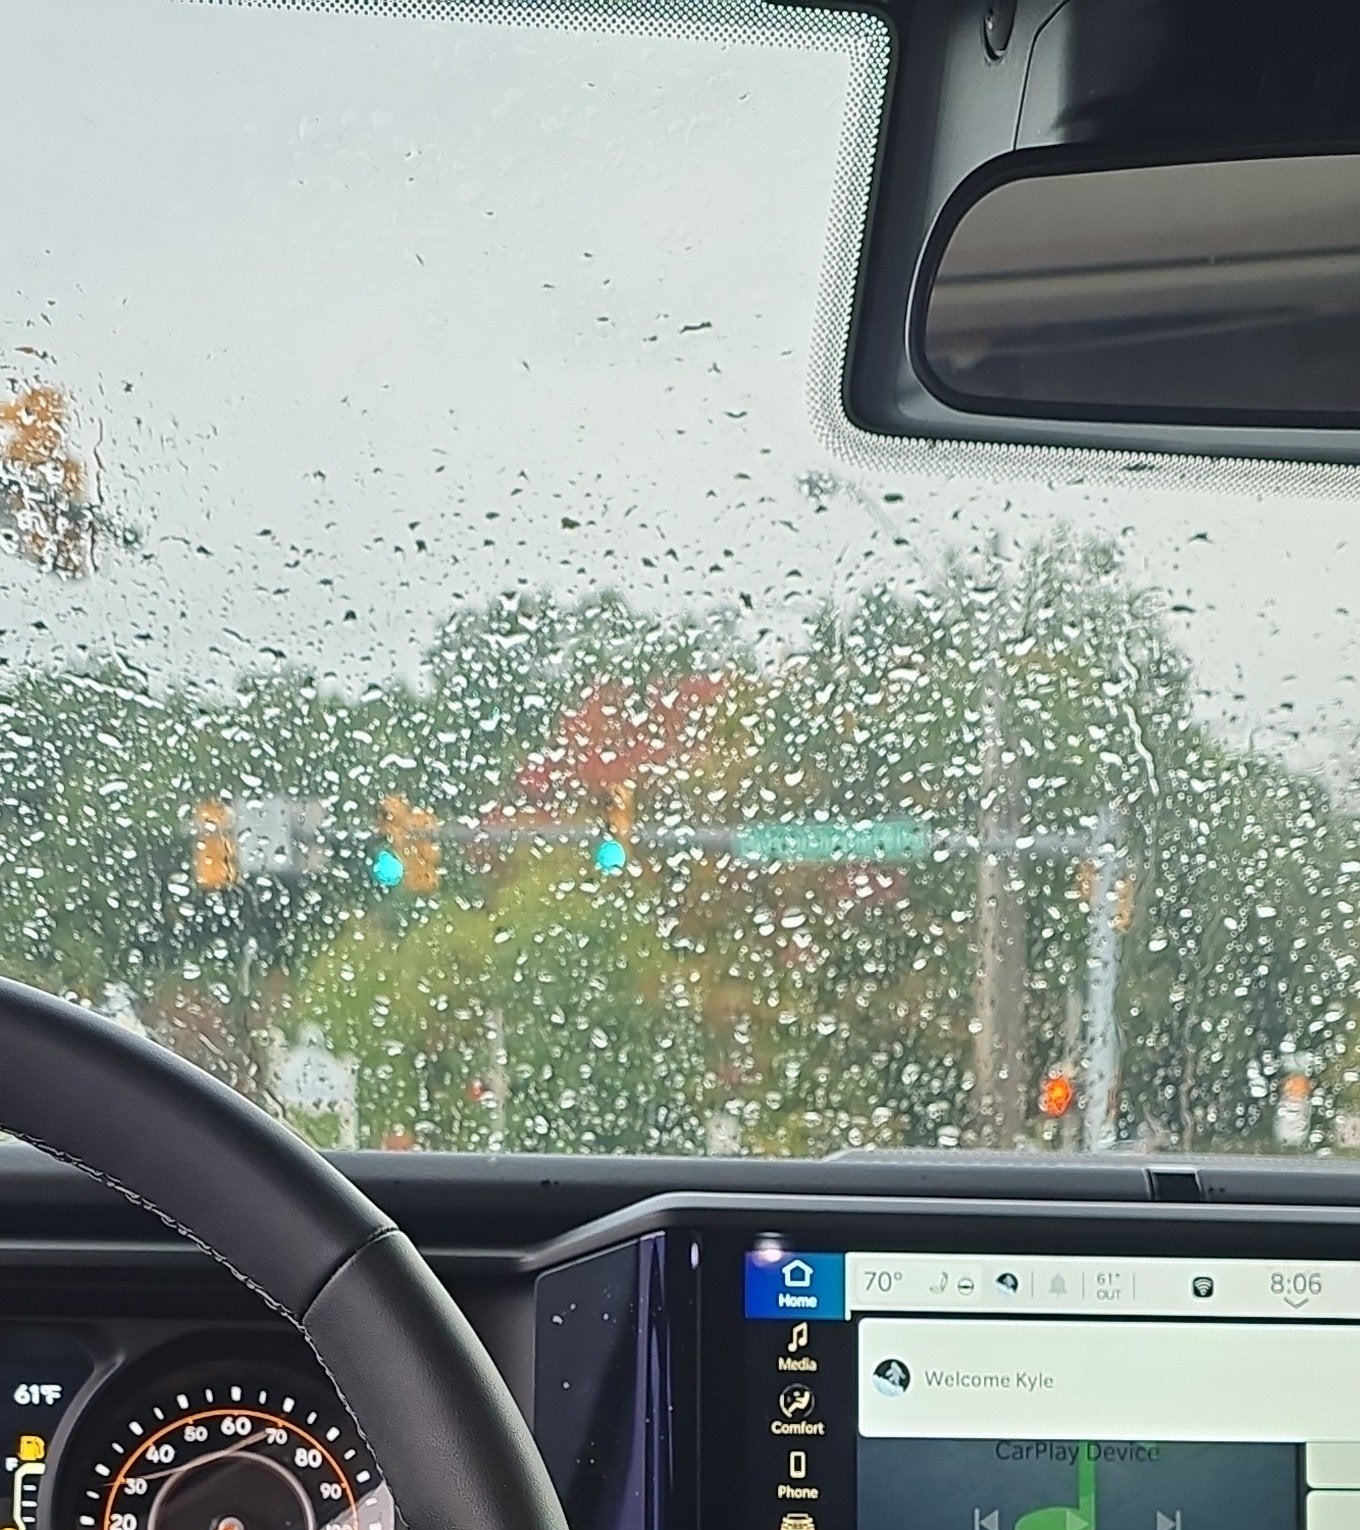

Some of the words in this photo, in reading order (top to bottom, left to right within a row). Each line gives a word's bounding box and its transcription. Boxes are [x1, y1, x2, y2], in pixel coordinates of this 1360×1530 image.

[864, 1270, 903, 1293] 70°
[1269, 1272, 1323, 1297] 8:06
[777, 1293, 818, 1309] Home
[1096, 1288, 1122, 1301] OUT
[777, 1356, 818, 1372] Media
[924, 1370, 1012, 1389] Welcome
[1015, 1371, 1055, 1392] Kyle
[183, 1425, 209, 1442] 50
[220, 1416, 252, 1436] 60
[770, 1420, 826, 1436] Comfort
[265, 1427, 288, 1445] 70
[145, 1443, 176, 1464] 40
[294, 1447, 323, 1469] 80
[994, 1441, 1080, 1466] CarPlay
[1086, 1442, 1160, 1463] Device
[5, 1457, 19, 1471] F
[124, 1477, 148, 1495] 30
[319, 1482, 342, 1500] 90
[777, 1484, 819, 1499] Phone
